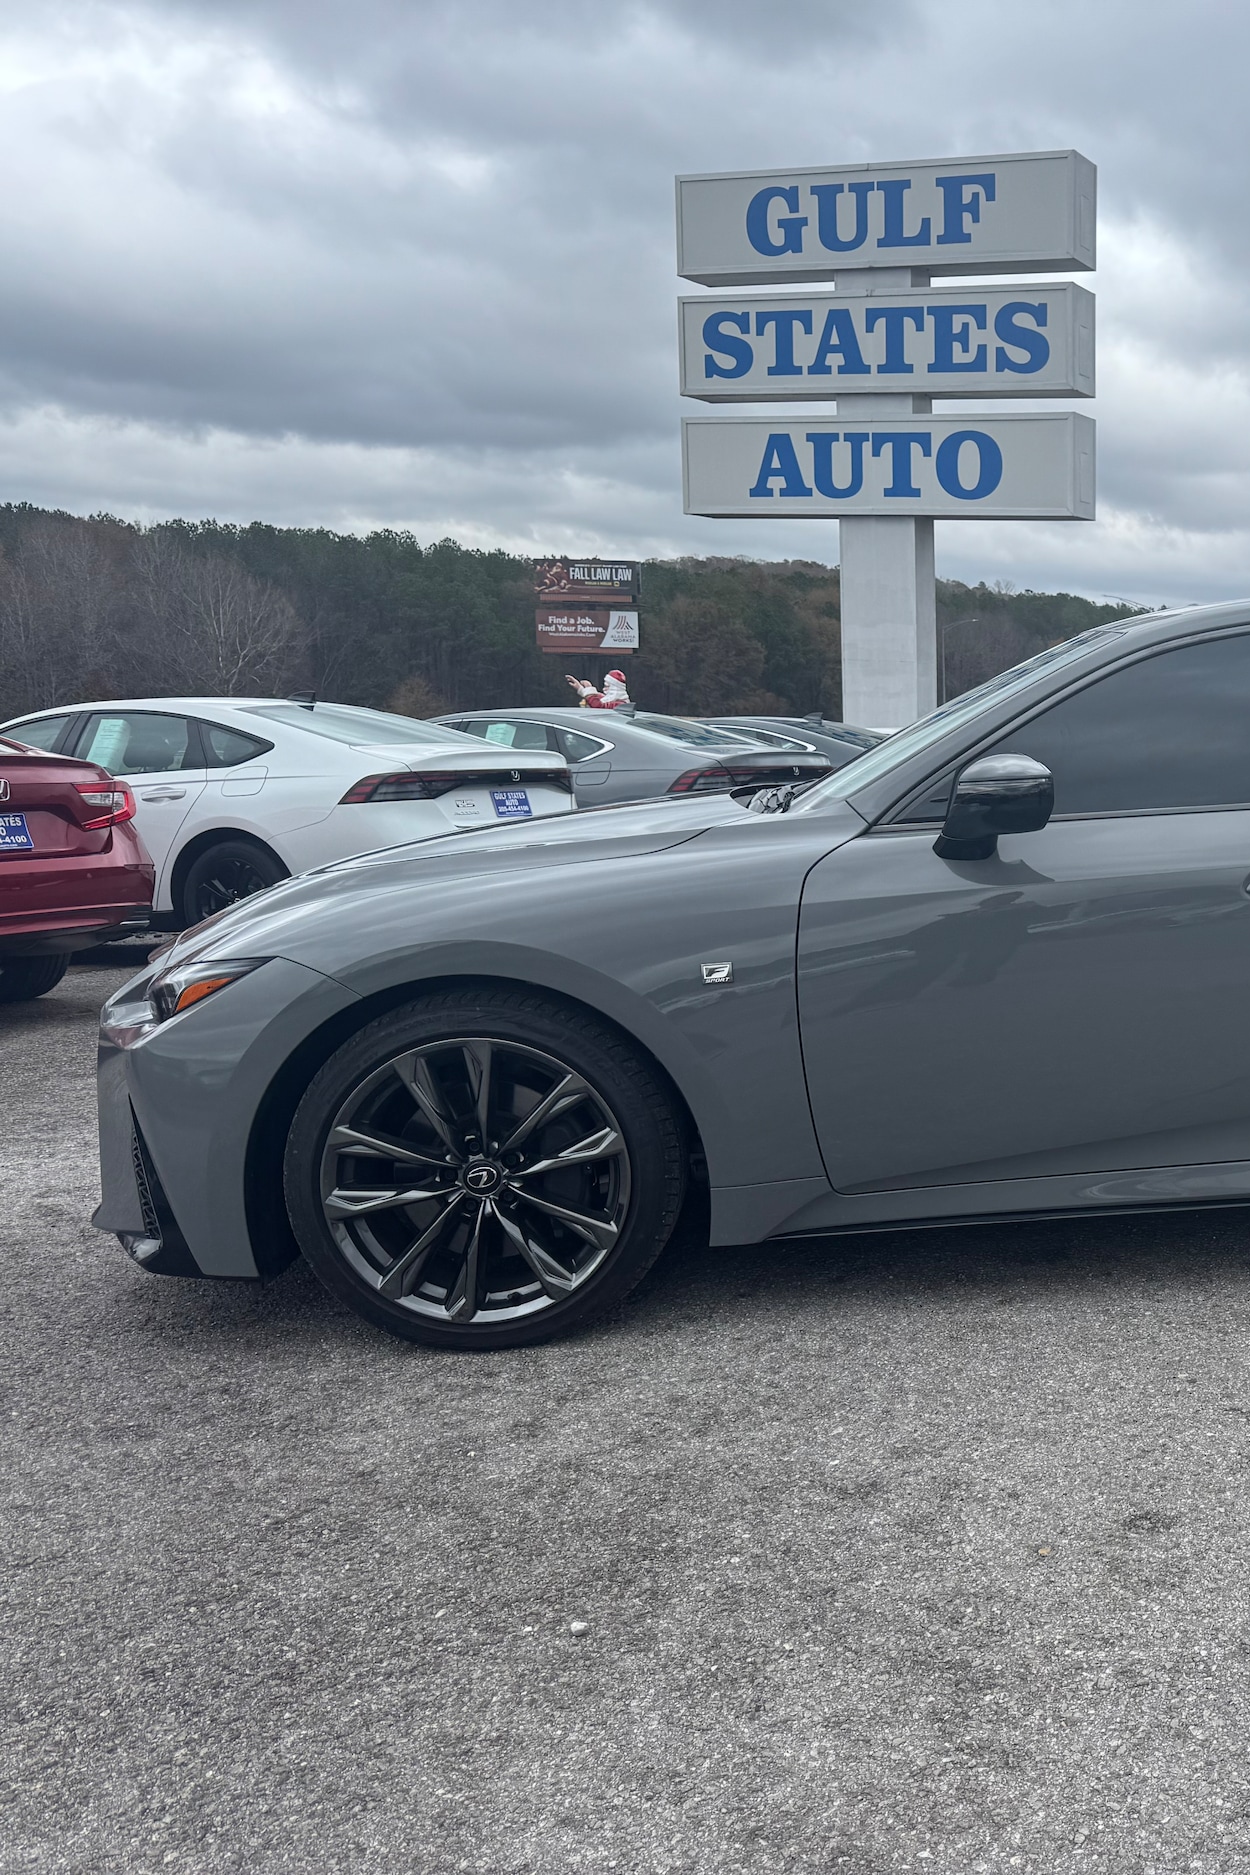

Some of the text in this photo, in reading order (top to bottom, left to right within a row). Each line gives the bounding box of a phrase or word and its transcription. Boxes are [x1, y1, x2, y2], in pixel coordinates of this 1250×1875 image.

[746, 173, 996, 257] GULF
[702, 301, 1050, 379] STATES
[749, 430, 1003, 500] AUTO
[569, 567, 632, 581] FALL LAW LAW
[538, 624, 605, 633] Find Your Future.
[549, 616, 567, 624] Find
[577, 616, 594, 625] Job.
